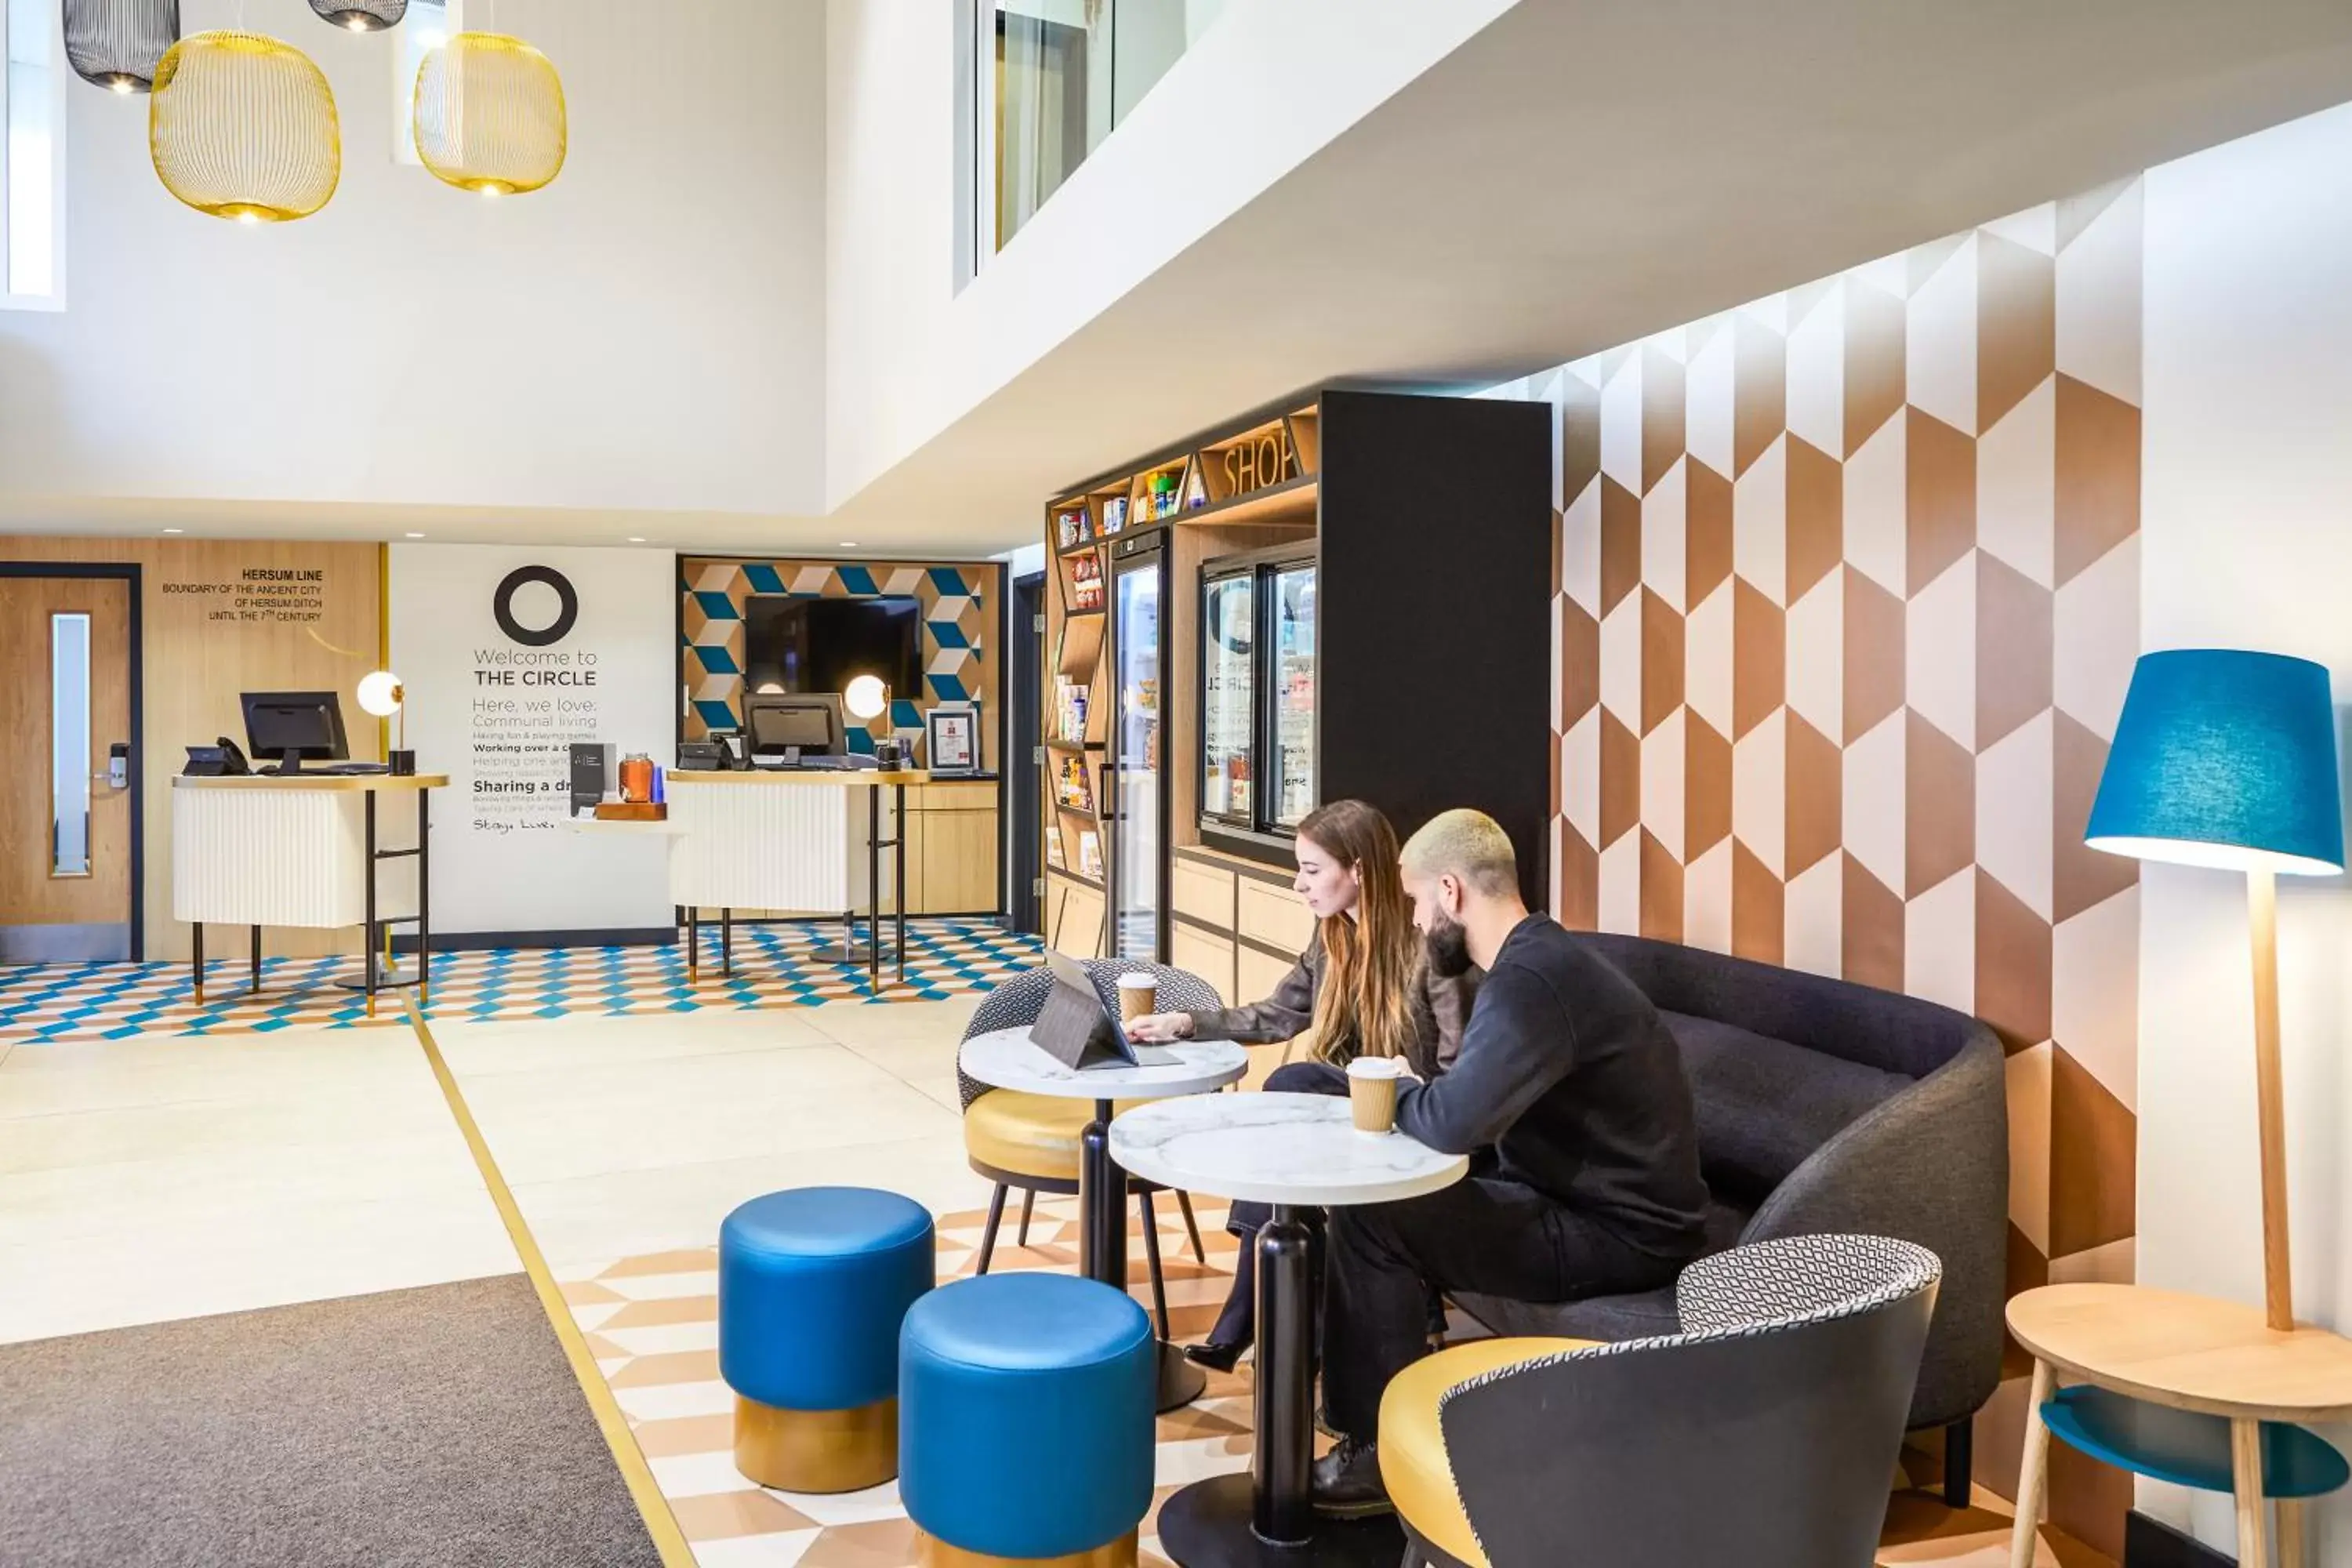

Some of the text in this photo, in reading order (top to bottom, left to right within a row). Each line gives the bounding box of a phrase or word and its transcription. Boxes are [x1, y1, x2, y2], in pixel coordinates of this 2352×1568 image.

[242, 569, 323, 581] HERSUM LINE
[162, 583, 322, 595] BOUNDARY OF THE ANCIENT CITY
[234, 598, 322, 608] OF HERSUM DITCH
[209, 609, 322, 622] UNTIL THE 7TH CENTURY
[474, 648, 598, 666] Welcome to
[474, 670, 597, 686] THE CIRCLE
[525, 700, 551, 712] we
[473, 714, 597, 728] Communal living
[473, 732, 504, 741] Having
[473, 743, 521, 753] Working
[473, 757, 518, 768] Helping
[523, 757, 546, 767] one
[474, 780, 535, 794] Sharing
[540, 782, 550, 792] a
